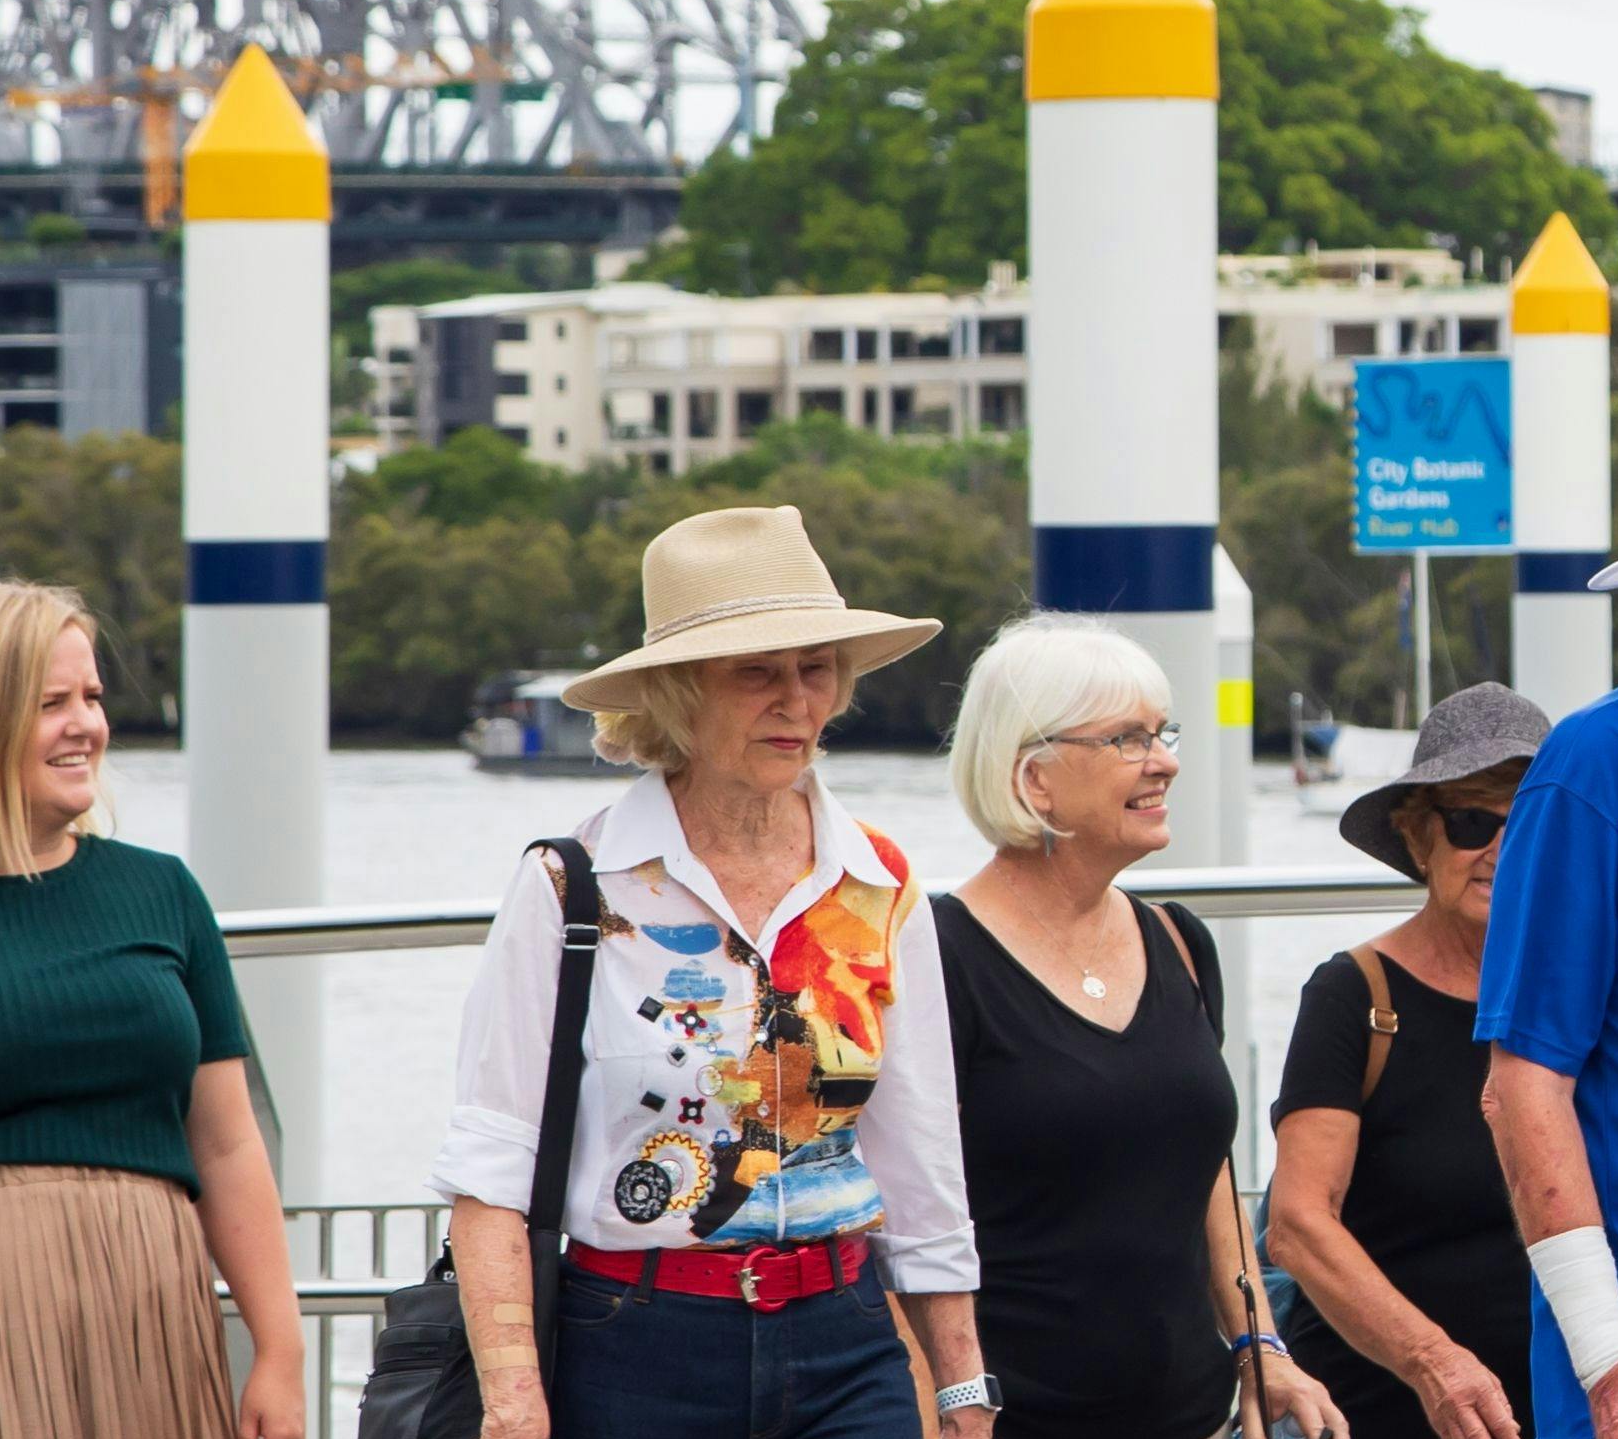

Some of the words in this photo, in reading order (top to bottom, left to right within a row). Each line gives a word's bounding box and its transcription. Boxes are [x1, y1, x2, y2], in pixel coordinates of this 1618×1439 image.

[1367, 457, 1409, 486] City
[1412, 456, 1485, 482] Botanic
[1368, 485, 1451, 511] Gardens
